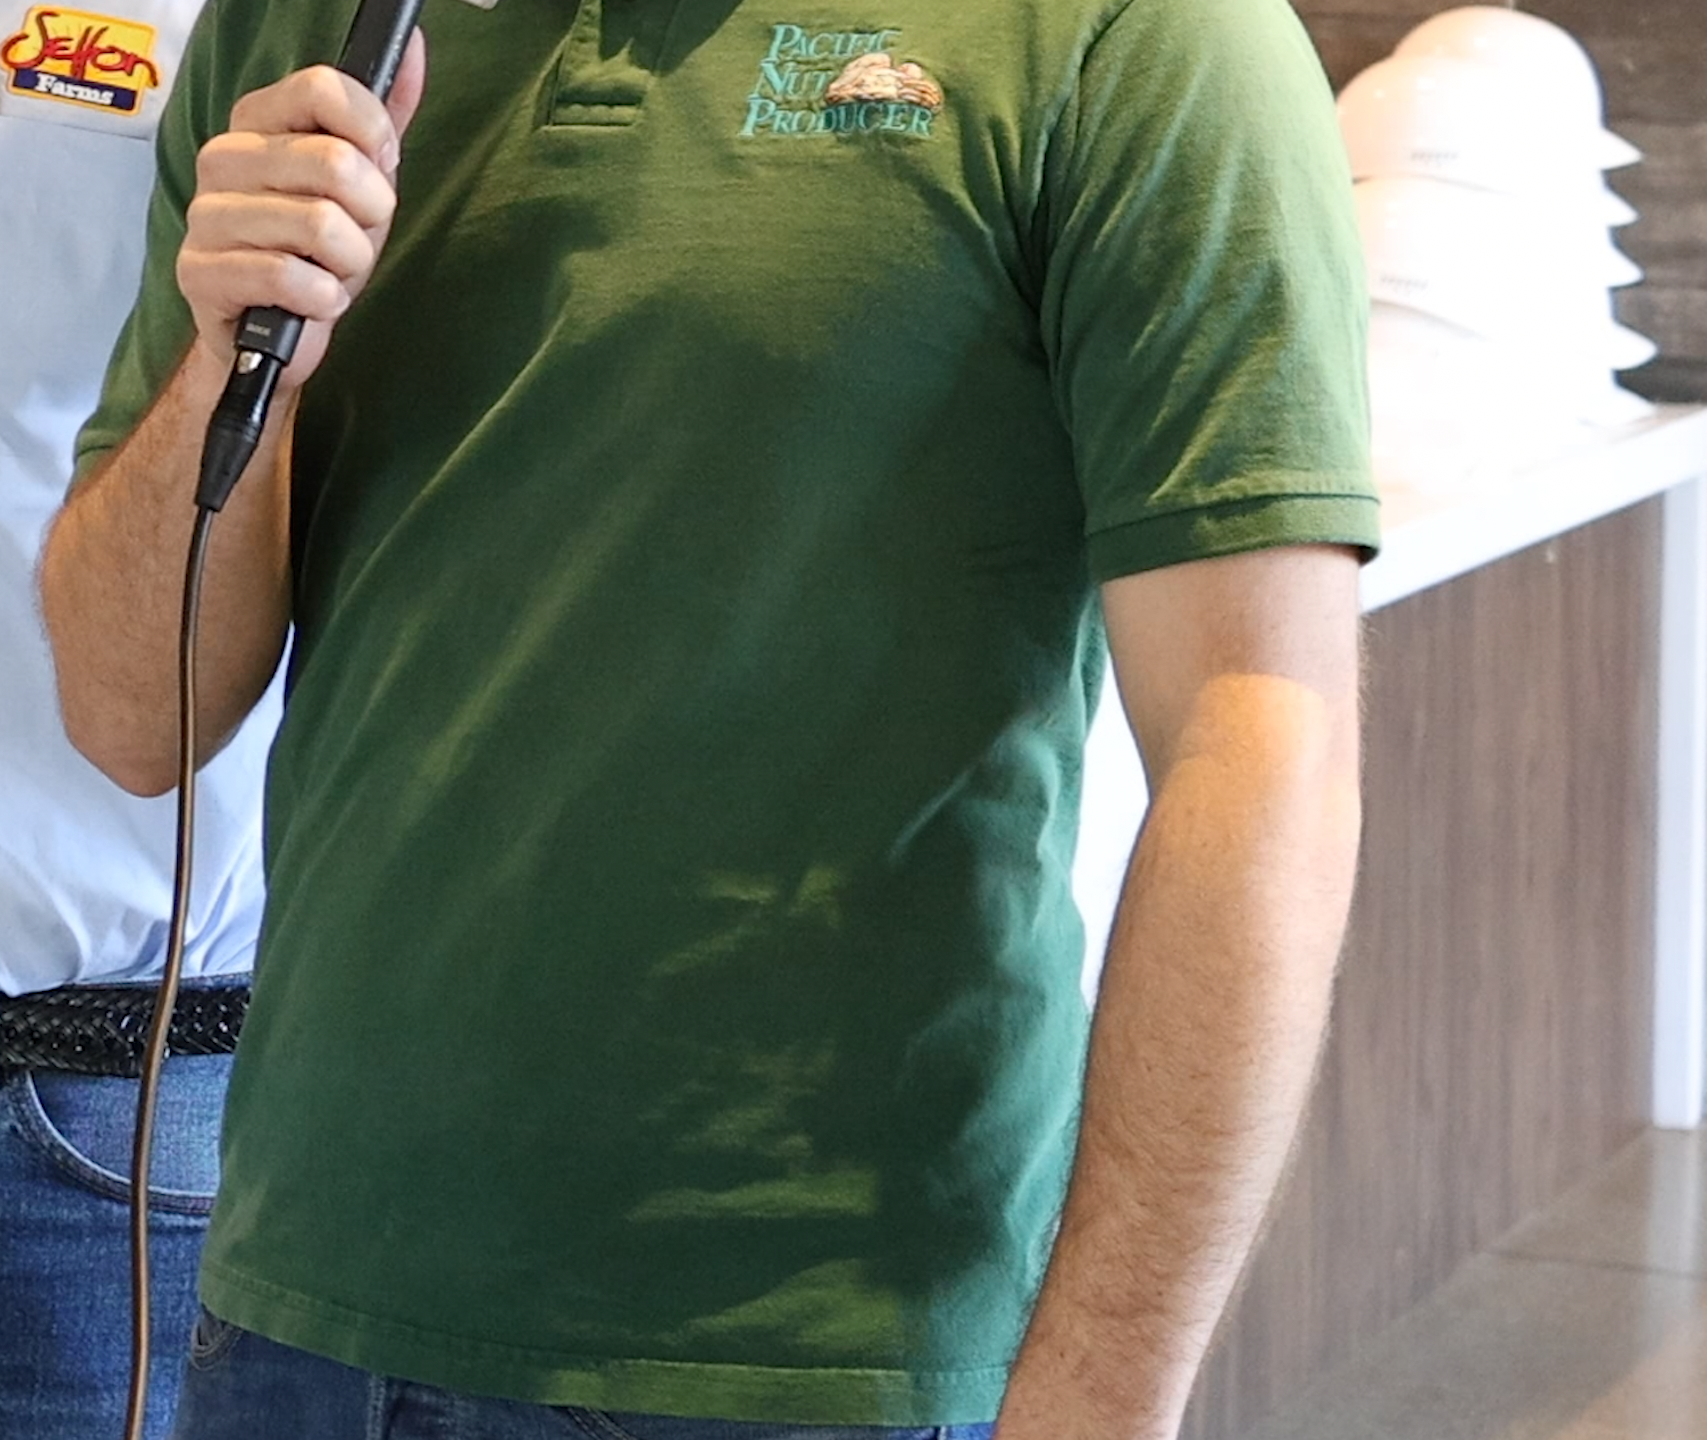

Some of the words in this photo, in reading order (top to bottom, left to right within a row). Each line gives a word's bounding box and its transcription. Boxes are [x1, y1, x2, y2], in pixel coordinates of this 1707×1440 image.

[0, 11, 159, 87] Sellon
[34, 72, 114, 106] Farms
[738, 96, 933, 138] PRODUCER
